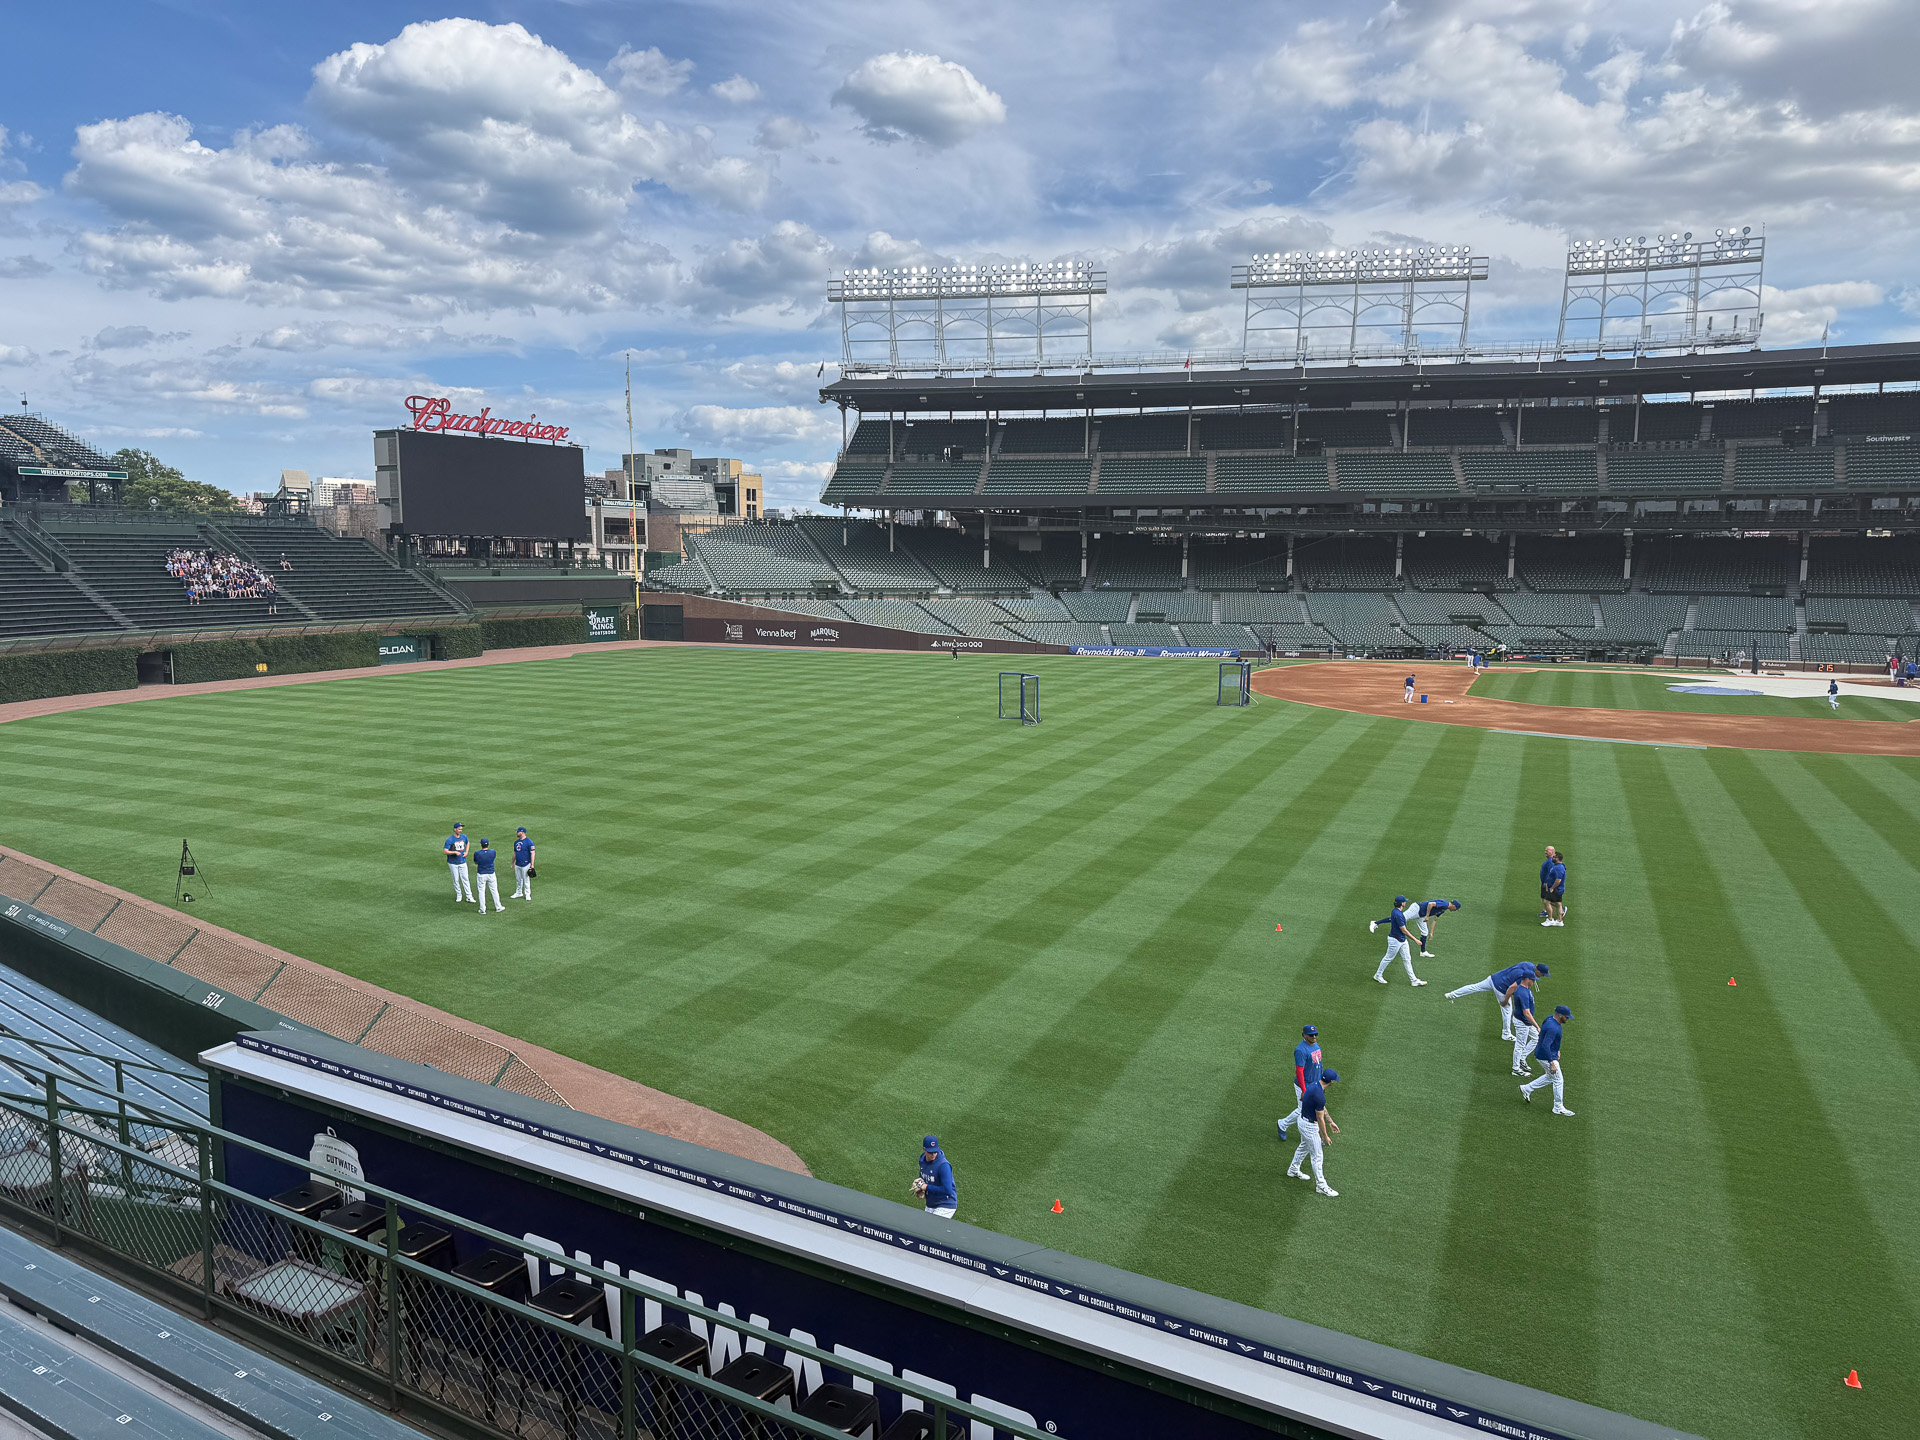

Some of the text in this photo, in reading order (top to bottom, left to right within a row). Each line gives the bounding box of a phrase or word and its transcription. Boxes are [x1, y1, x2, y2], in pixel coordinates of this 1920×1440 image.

[405, 395, 569, 441] Budweiser
[40, 468, 108, 478] WRIGLEYROOFTOPS.COM
[588, 614, 615, 625] DRAFT
[592, 622, 615, 631] KINGS
[810, 627, 840, 639] MARQUEE
[755, 627, 797, 640] Vienna Beef
[1075, 647, 1113, 656] Reynolds
[202, 991, 226, 1009] 504
[408, 1088, 427, 1099] CUTWATER
[503, 1117, 525, 1130] CUTWATER
[609, 1150, 634, 1163] CUTWATER
[326, 1153, 358, 1176] CUTWATER
[728, 1185, 757, 1200] CUTWATER
[778, 1200, 787, 1209] REAL
[787, 1202, 807, 1214] COCKTAILS.
[807, 1209, 826, 1220] PERFECTLY
[863, 1226, 893, 1242] CUTWATER
[919, 1243, 929, 1253] REAL
[929, 1246, 951, 1260] COCKTAILS.
[951, 1253, 973, 1267] PERFECTLY
[1014, 1273, 1157, 1325] CUTWATER REAL COCKTAILS. PERFECTLY MIXED.
[1189, 1328, 1229, 1347] CUTWATER
[1263, 1350, 1276, 1362] REAL
[1277, 1354, 1306, 1371] COCKTAILS.
[1335, 1372, 1354, 1386] MIXED.
[1392, 1390, 1437, 1411] CUTWATER
[1478, 1416, 1492, 1429] REAL
